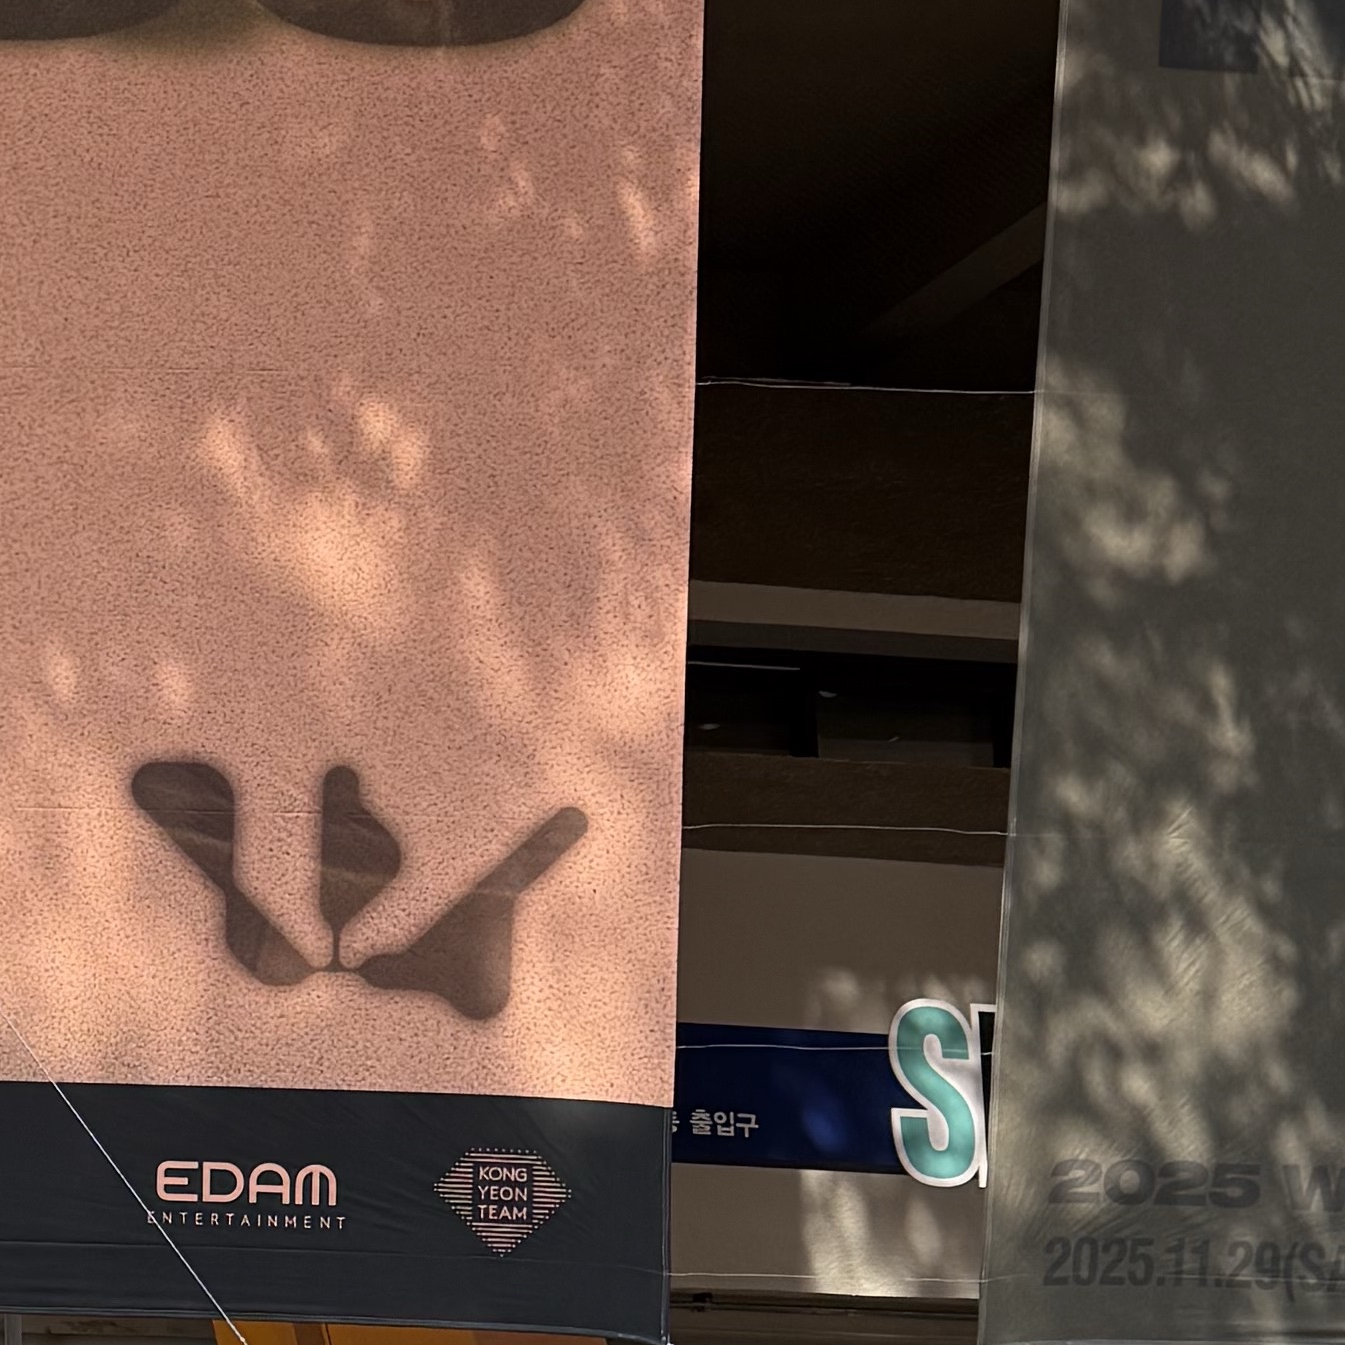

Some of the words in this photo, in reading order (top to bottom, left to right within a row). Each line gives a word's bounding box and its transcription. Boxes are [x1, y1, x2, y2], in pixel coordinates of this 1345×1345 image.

[690, 1109, 759, 1137] 출입구
[156, 1160, 337, 1206] EDAM
[479, 1166, 528, 1183] KONG
[1048, 1159, 1262, 1208] 2025
[479, 1186, 528, 1202] YEON
[147, 1212, 346, 1230] ENTERTAINMENT
[478, 1205, 528, 1222] TEAM
